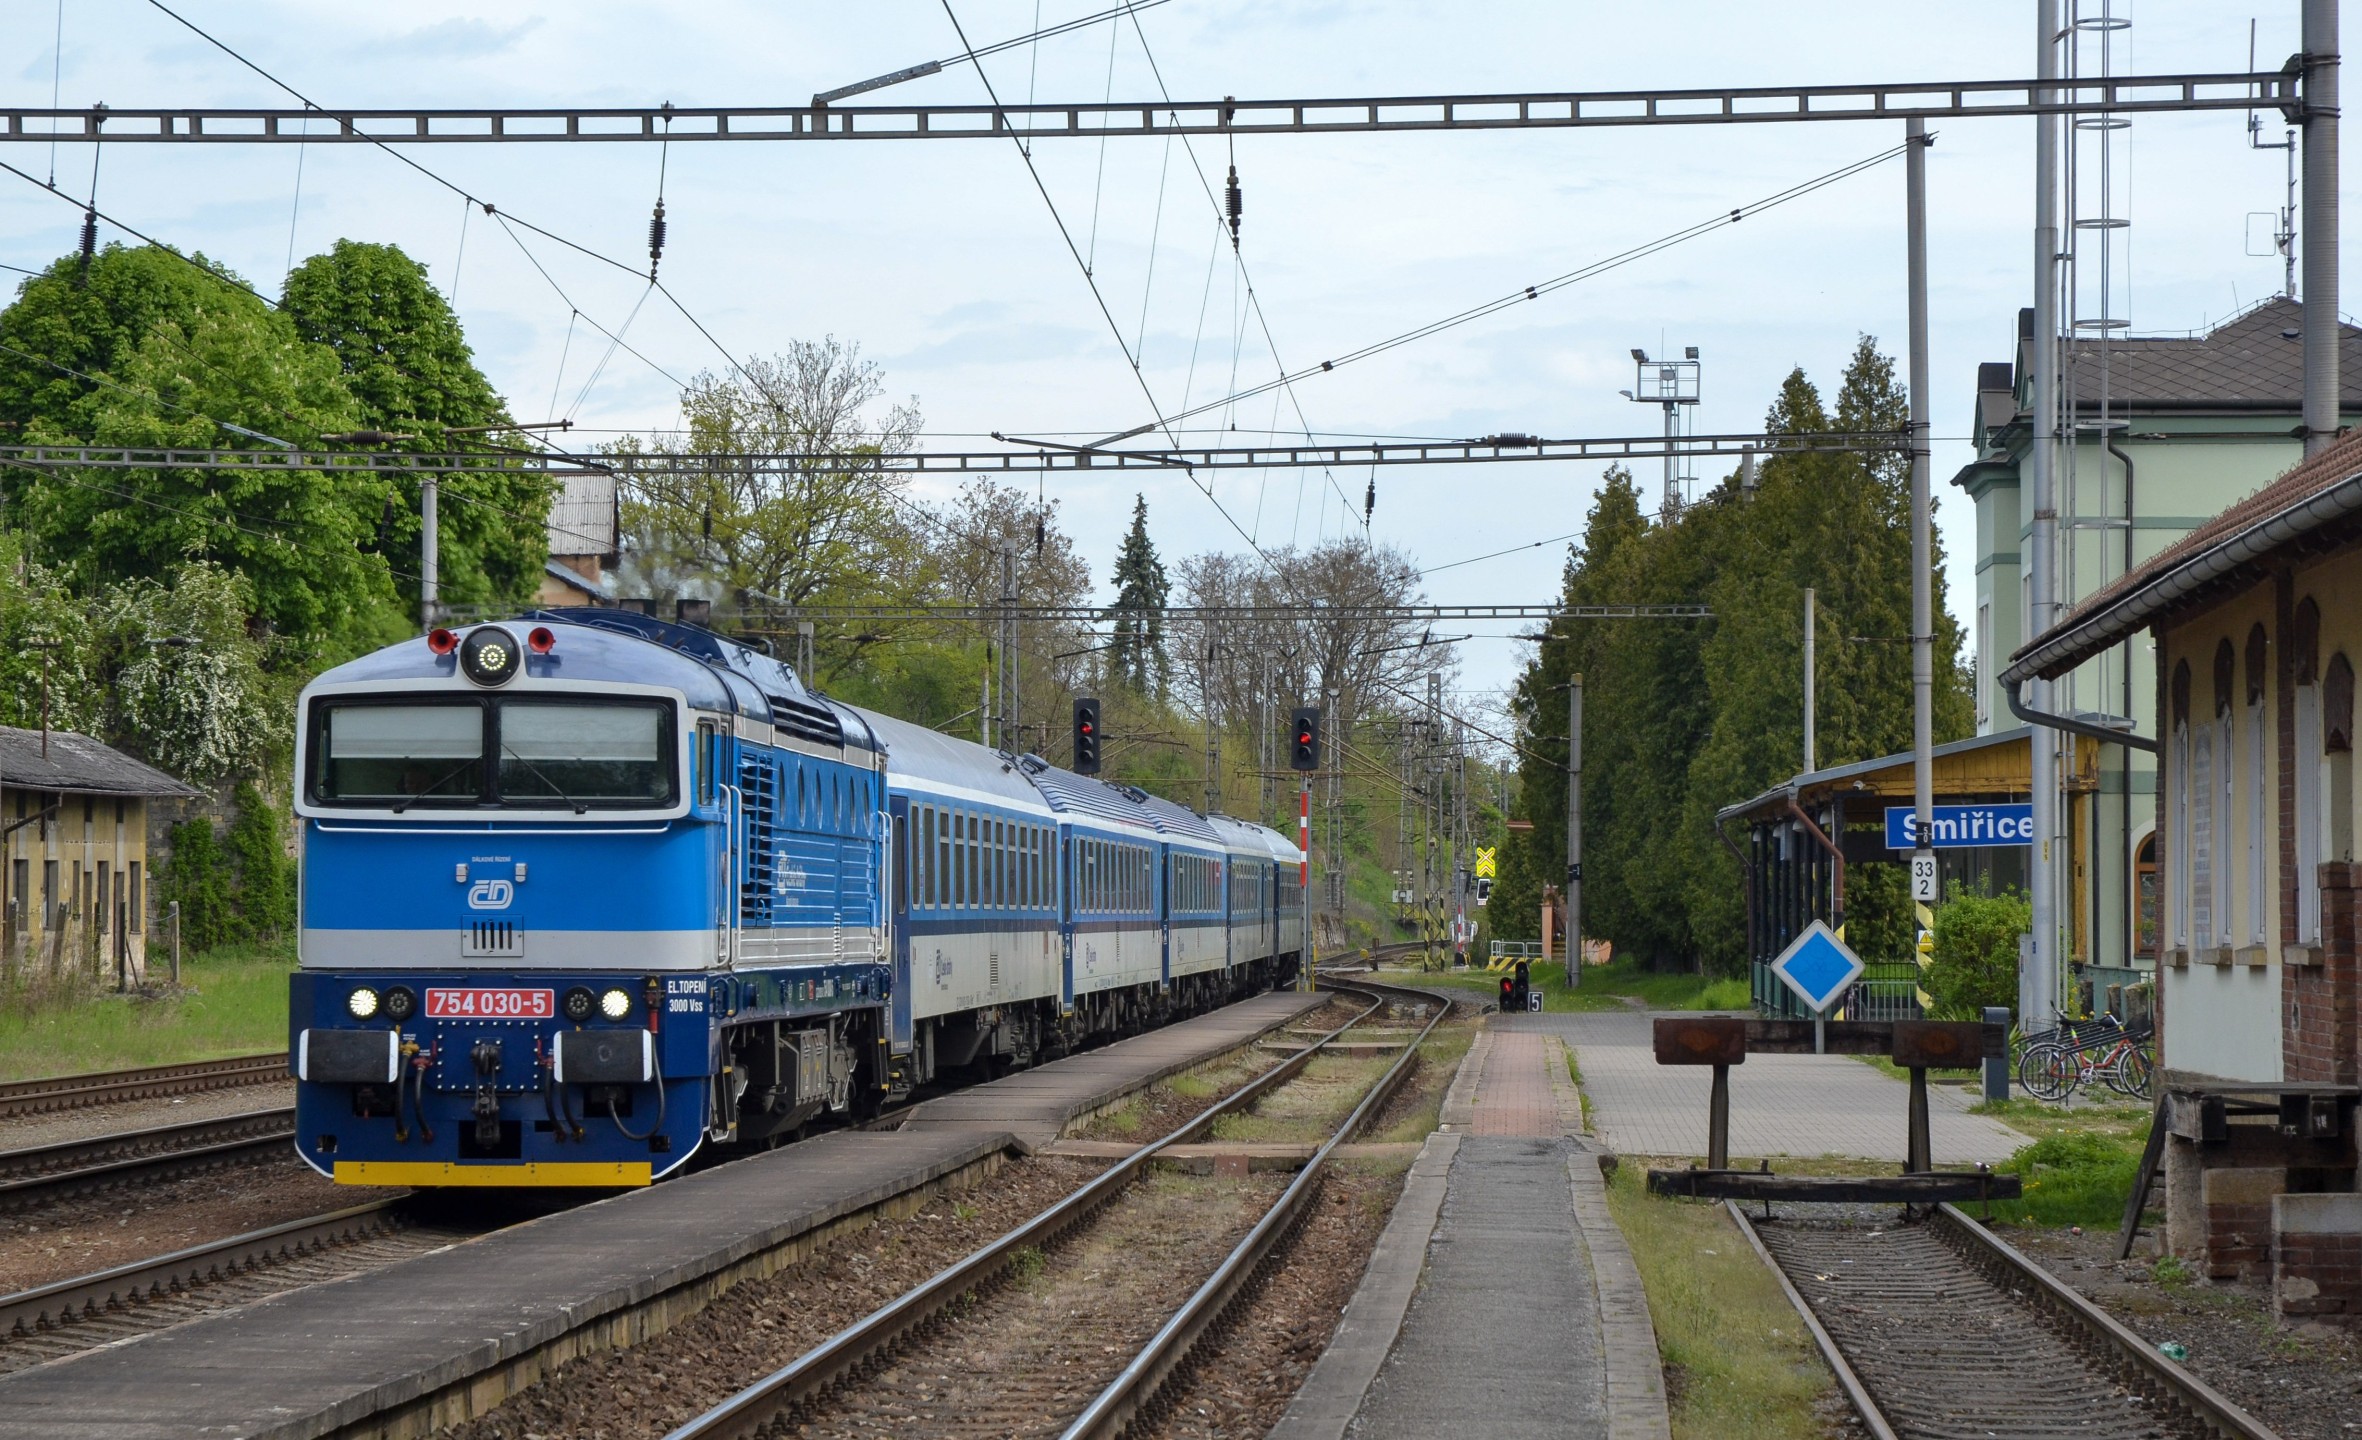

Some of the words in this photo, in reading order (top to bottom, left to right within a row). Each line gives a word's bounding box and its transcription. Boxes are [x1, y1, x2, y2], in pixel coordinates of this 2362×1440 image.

[1903, 811, 2033, 841] Smiřice
[1915, 861, 1934, 877] 33
[1919, 880, 1929, 895] 2
[433, 991, 475, 1014] 754
[480, 992, 546, 1015] 030-5
[668, 999, 688, 1012] 3000
[690, 999, 704, 1012] Vss
[1531, 994, 1540, 1012] 5
